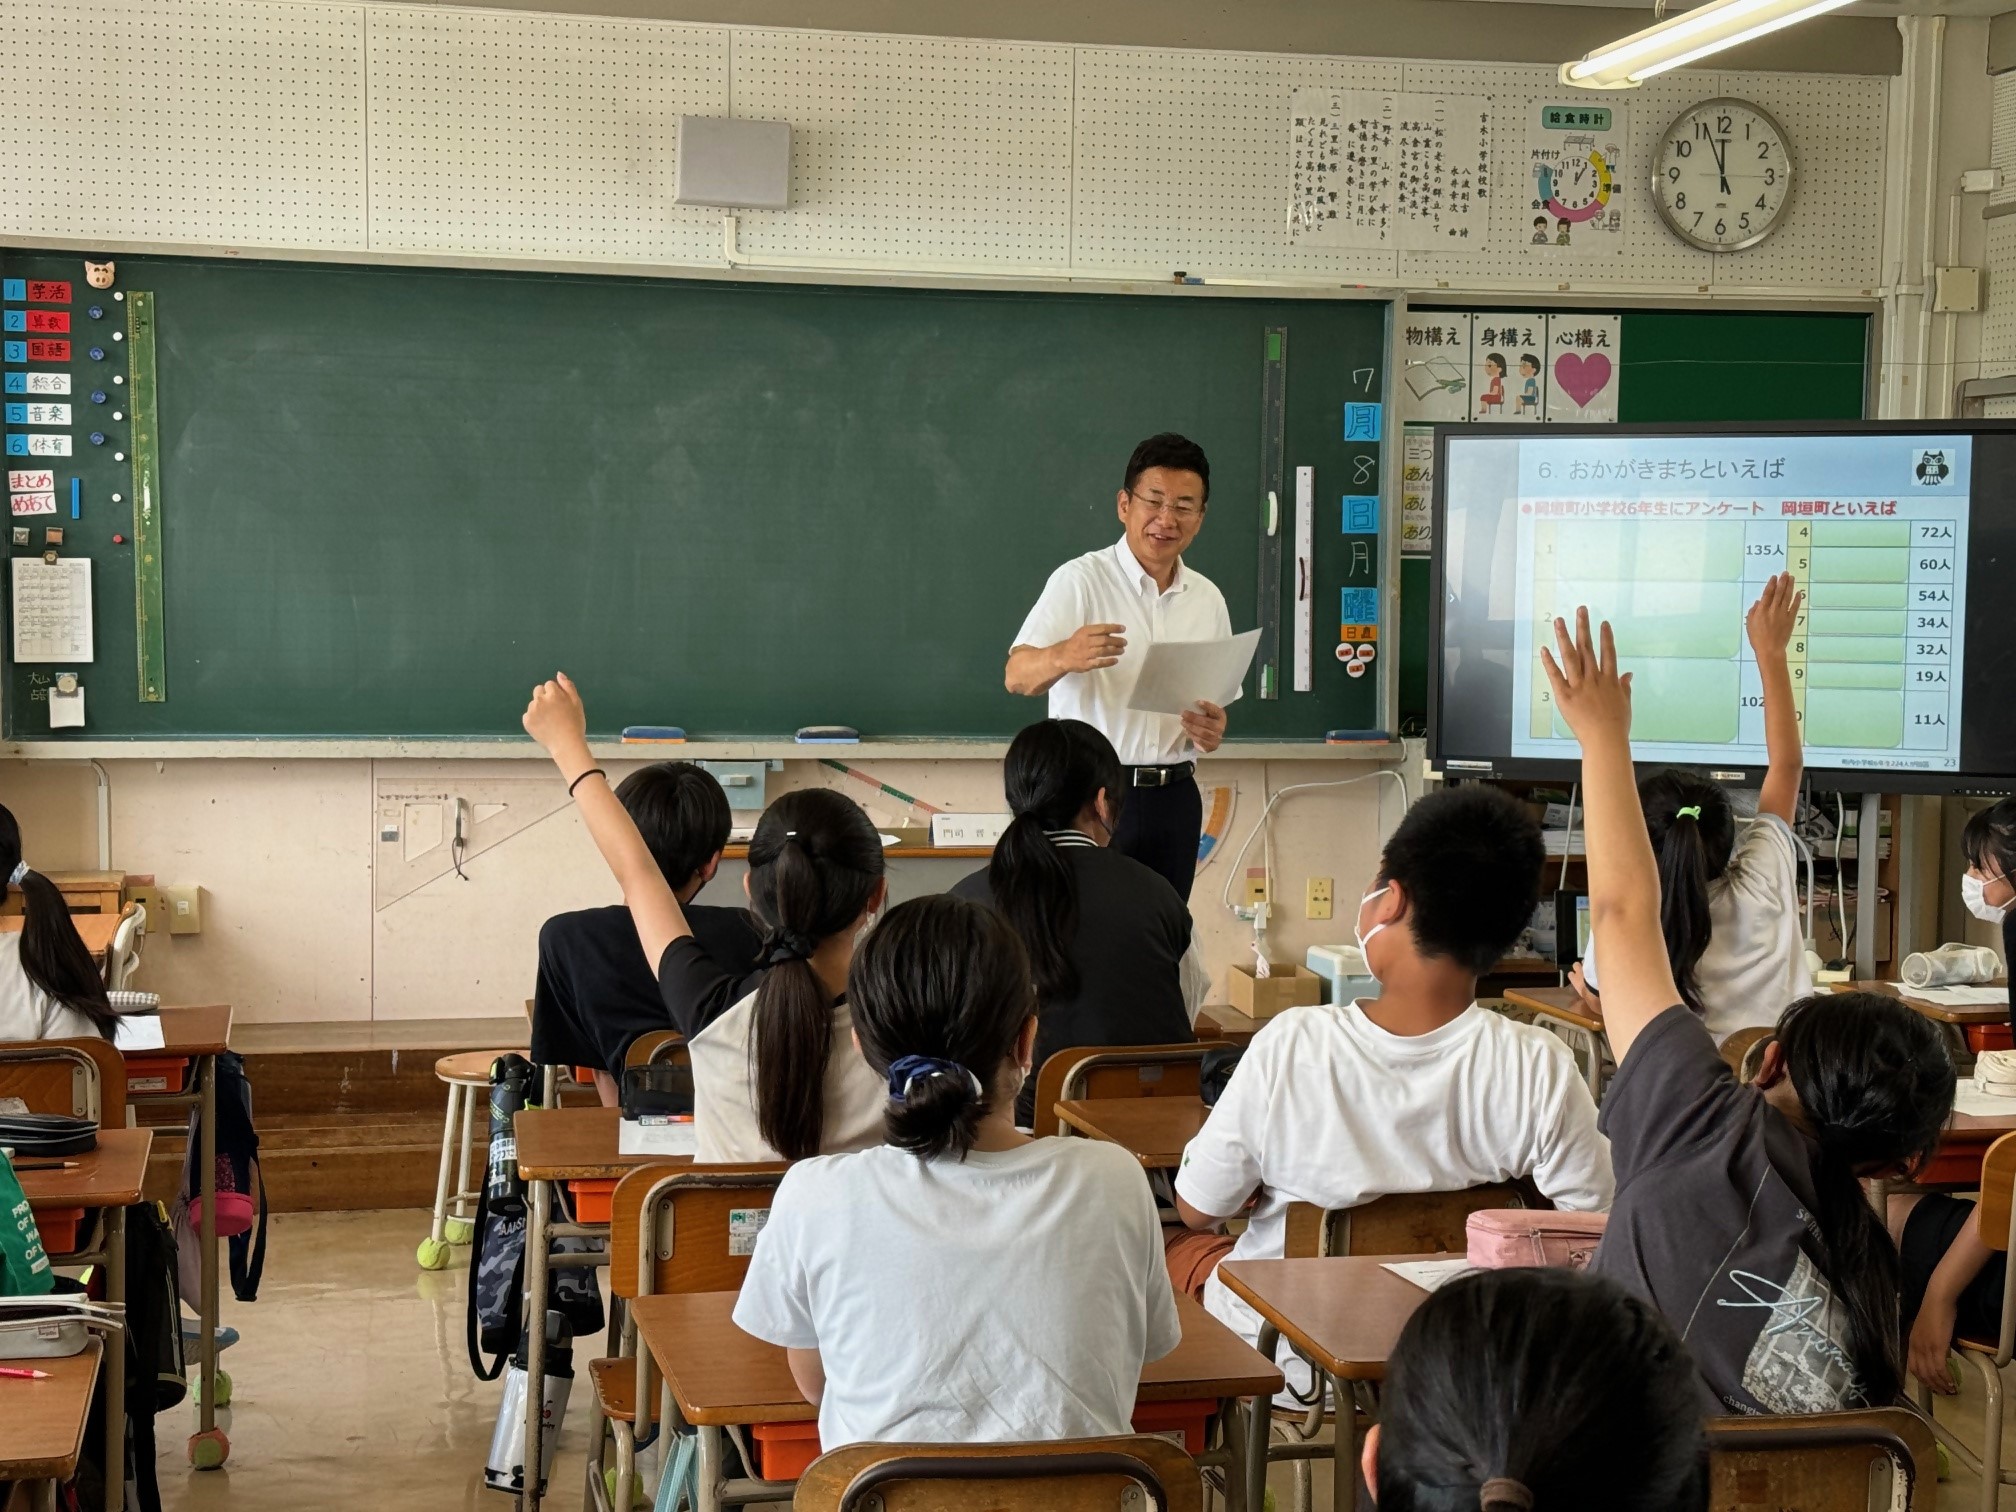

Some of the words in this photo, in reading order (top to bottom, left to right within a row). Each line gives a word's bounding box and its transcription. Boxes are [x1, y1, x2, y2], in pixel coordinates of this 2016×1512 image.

[1550, 112, 1604, 125] 給食時計
[1717, 116, 1732, 134] 12
[1745, 123, 1750, 140] 1
[1531, 149, 1560, 160] 片付け
[1676, 140, 1692, 157] 10
[1758, 141, 1769, 159] 2
[1669, 167, 1680, 184] 9
[1765, 168, 1775, 185] 3
[1675, 192, 1686, 209] 8
[1755, 194, 1766, 210] 4
[1693, 212, 1704, 227] 7
[1715, 218, 1726, 235] 6
[1738, 212, 1750, 229] 5
[12, 284, 16, 297] 1
[11, 315, 19, 328] 2
[1406, 326, 1461, 346] 物構え
[1481, 327, 1536, 347] 身構え
[1555, 328, 1611, 347] 心構え
[9, 344, 20, 359] 3
[31, 342, 63, 358] 国語
[8, 377, 22, 391] 4
[1352, 368, 1374, 392] 7
[11, 407, 23, 421] 5
[29, 405, 64, 422] 音楽
[1346, 404, 1378, 439] 月
[12, 438, 22, 451] 6
[32, 436, 63, 454] 体育
[1352, 455, 1375, 484] 8
[1569, 457, 1786, 480] おかがきまちといえば
[10, 473, 52, 489] まとめ
[12, 495, 54, 511] めあて
[1781, 501, 1898, 516] 岡垣町といえば
[1348, 499, 1375, 530] 日
[1404, 525, 1432, 540] あり
[1800, 527, 1808, 538] 4
[1921, 527, 1952, 538] 72人
[1746, 544, 1784, 556] 135人
[1349, 542, 1370, 577] 月
[1799, 559, 1807, 569] 5
[1920, 558, 1951, 570] 60人
[1918, 590, 1950, 602] 54人
[1344, 588, 1375, 622] 曜
[1797, 616, 1806, 626] 7
[1917, 617, 1949, 628] 34人
[1796, 642, 1805, 653] 8
[1916, 644, 1948, 655] 32人
[1795, 669, 1803, 679] 9
[1916, 671, 1947, 682] 19人
[1914, 714, 1945, 725] 11人
[1944, 758, 1956, 767] 23
